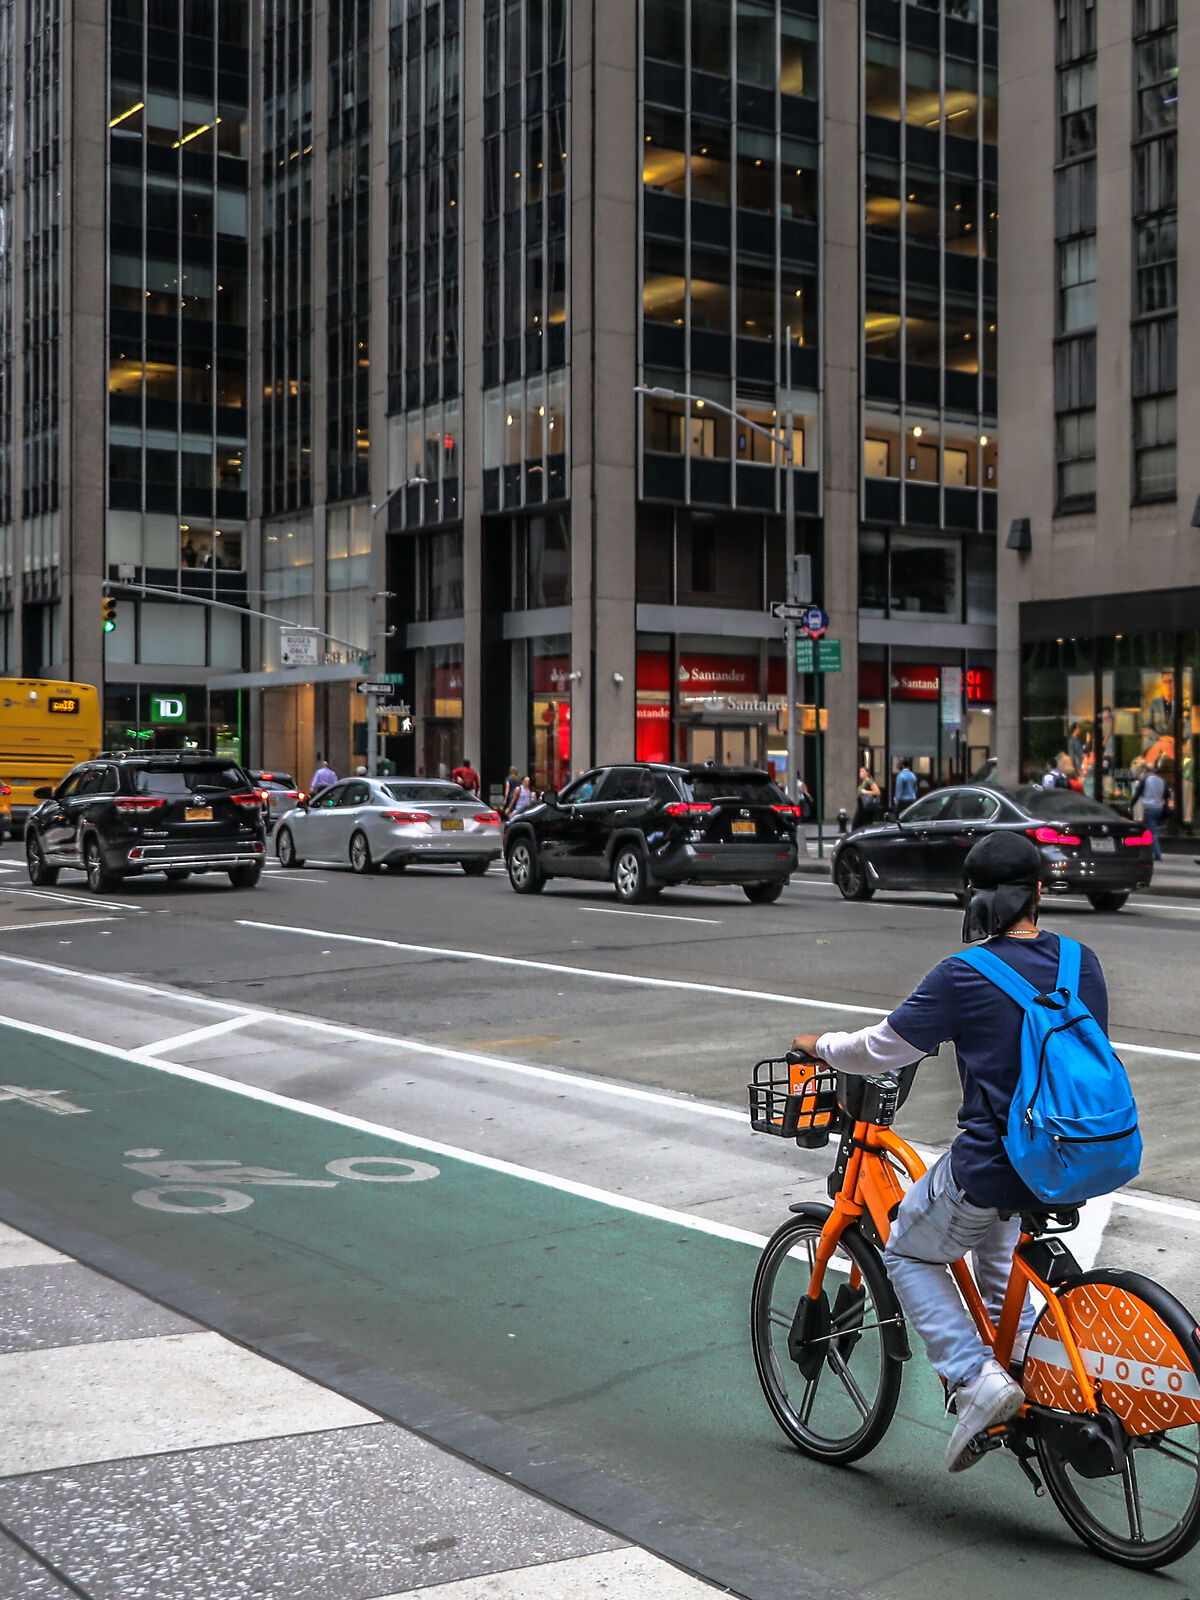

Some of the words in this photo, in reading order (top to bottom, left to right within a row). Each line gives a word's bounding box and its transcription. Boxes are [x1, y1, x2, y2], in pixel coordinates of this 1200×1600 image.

[691, 668, 745, 681] Santander
[900, 678, 939, 689] Santand
[154, 698, 184, 717] TD
[727, 696, 786, 711] Santand
[637, 708, 670, 718] ntande
[1094, 1356, 1183, 1392] JOCO
